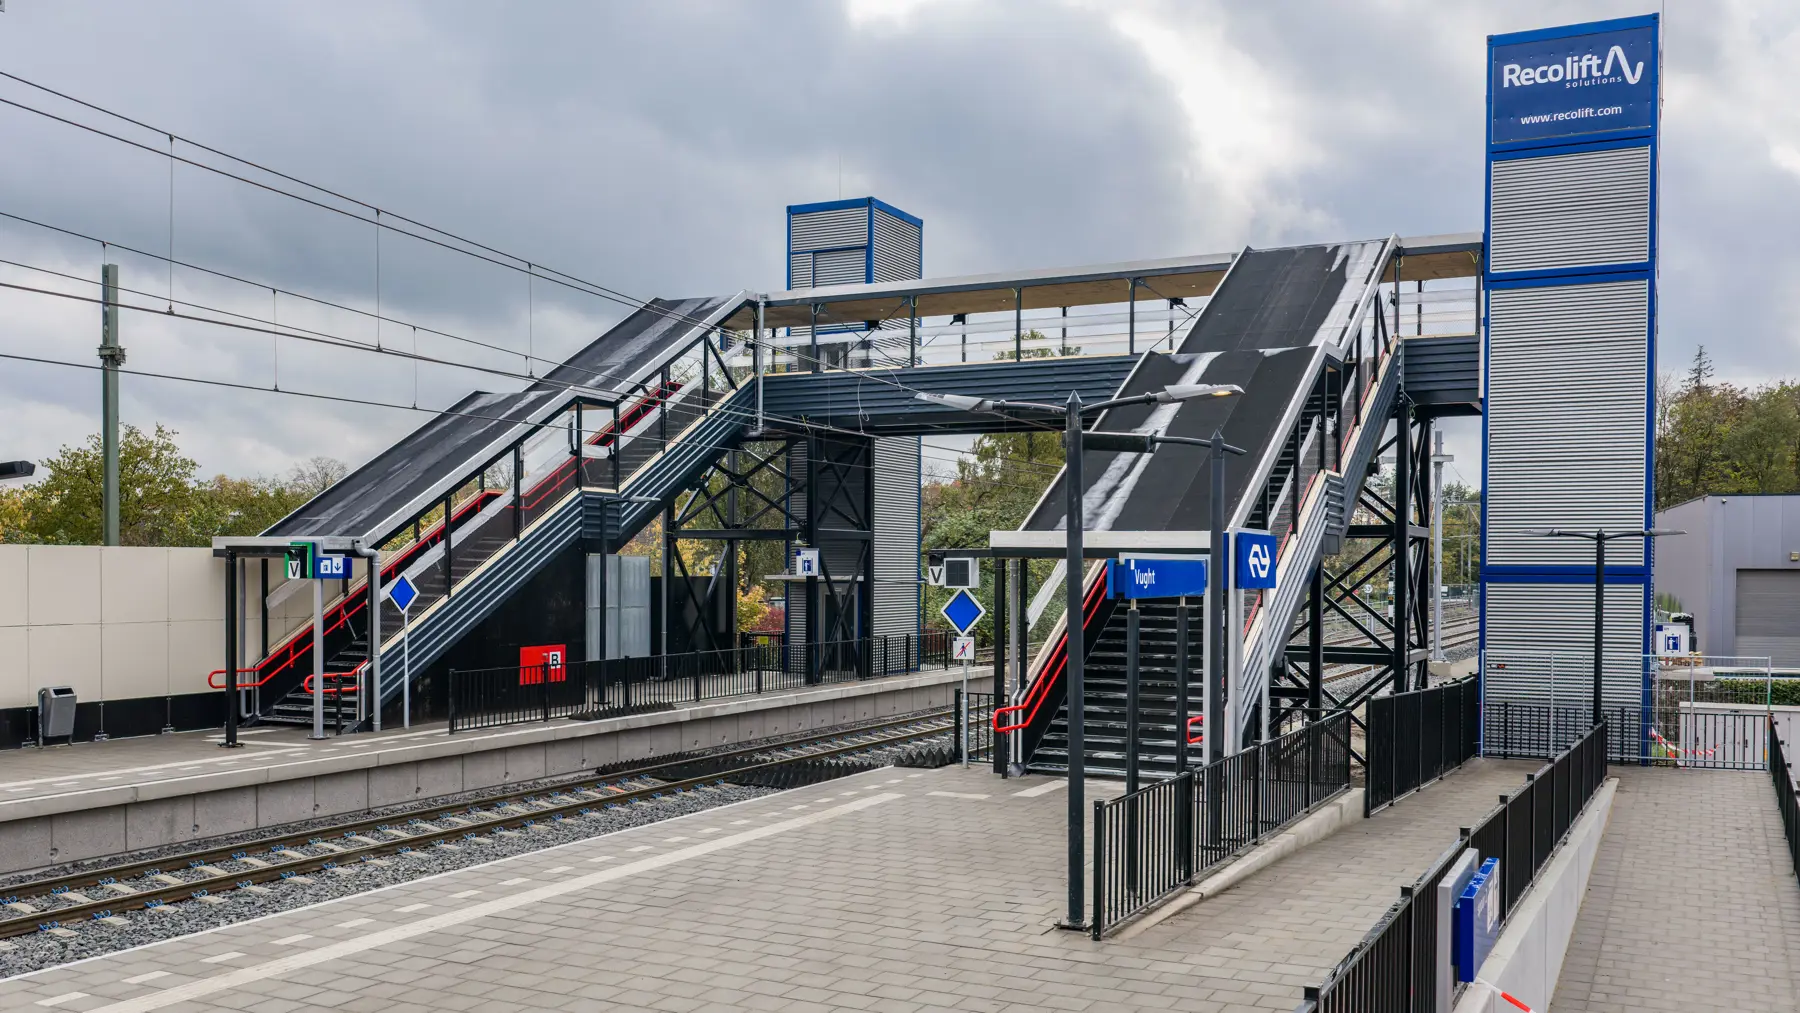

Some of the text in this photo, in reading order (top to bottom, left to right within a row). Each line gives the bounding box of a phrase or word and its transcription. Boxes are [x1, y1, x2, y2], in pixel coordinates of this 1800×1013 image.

[1503, 54, 1602, 88] Recolift
[1566, 76, 1622, 89] solutions
[1521, 105, 1622, 125] www.recolift.com
[289, 562, 299, 577] V
[930, 567, 943, 583] V
[1134, 567, 1156, 589] Vught
[551, 653, 559, 667] B
